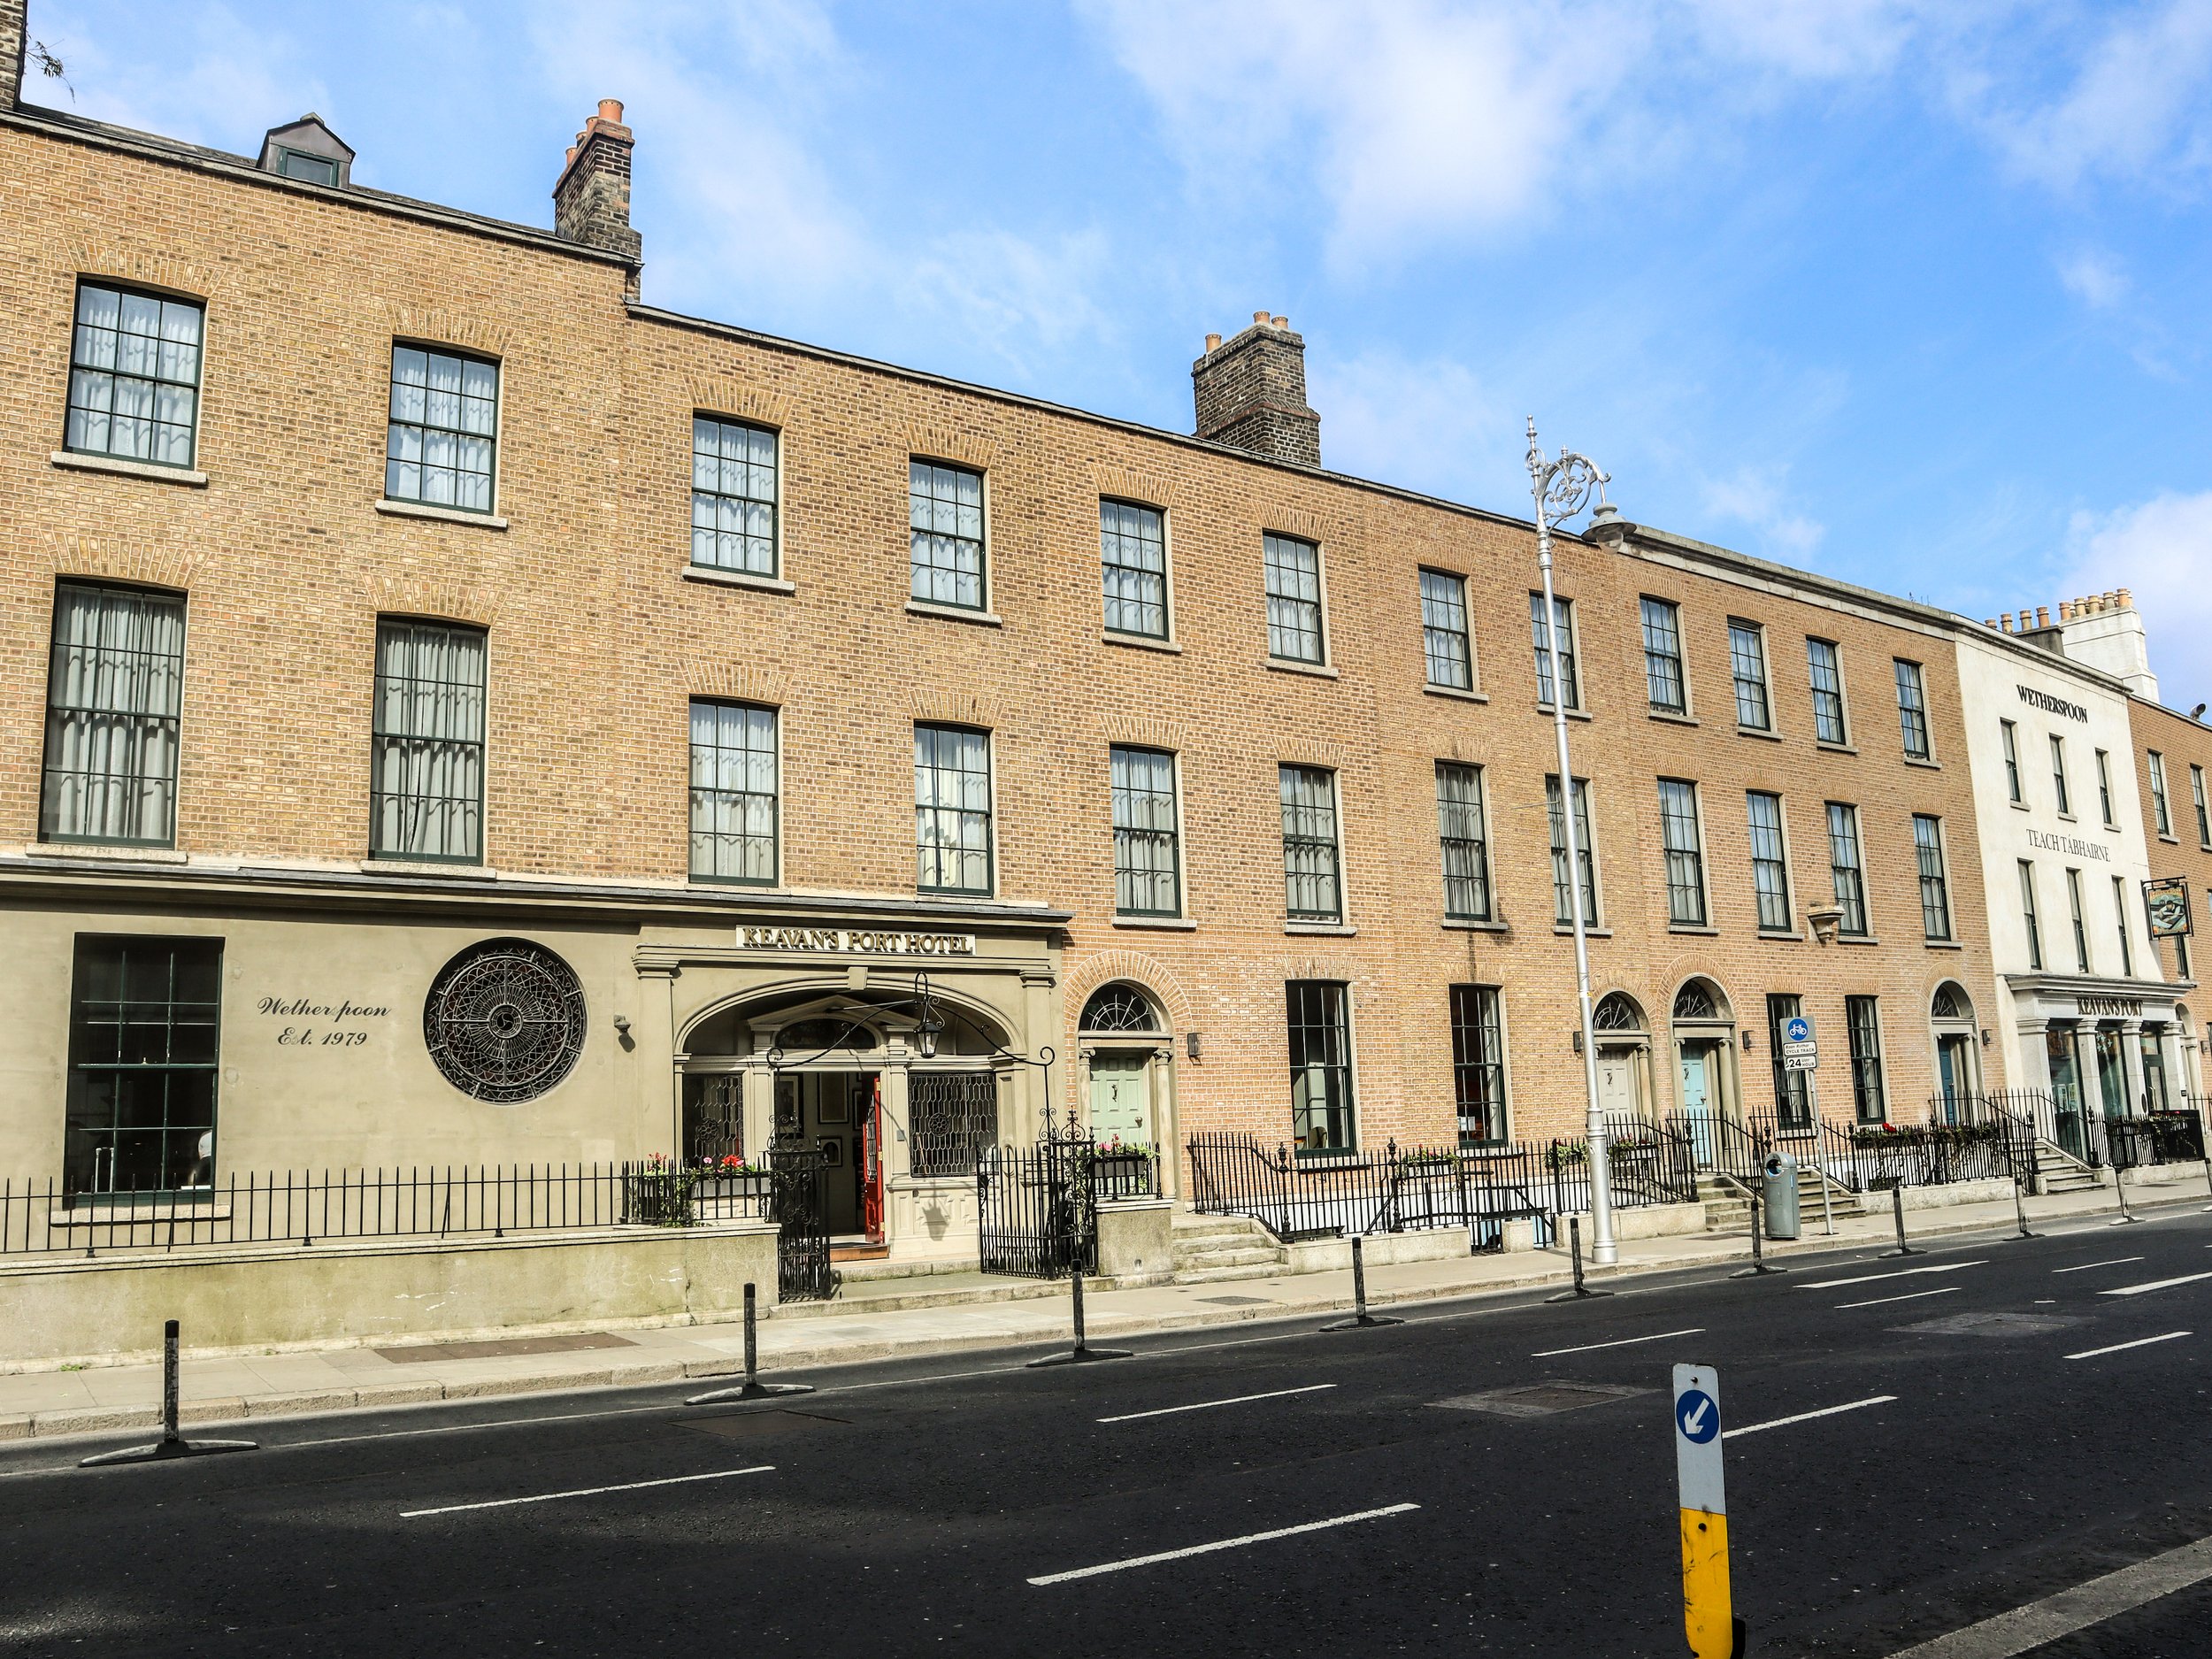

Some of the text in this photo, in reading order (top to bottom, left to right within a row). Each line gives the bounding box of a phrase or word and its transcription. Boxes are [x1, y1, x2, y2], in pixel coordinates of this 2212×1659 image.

[2016, 684, 2088, 724] WETHERSPOON
[2026, 829, 2111, 862] TEACH TÁBHAIRNE
[743, 927, 973, 956] KEAVAN'S PORT HOTEL
[257, 996, 392, 1022] Wetherpoon
[277, 1026, 367, 1047] Et. 1979
[1788, 1058, 1801, 1068] 24
